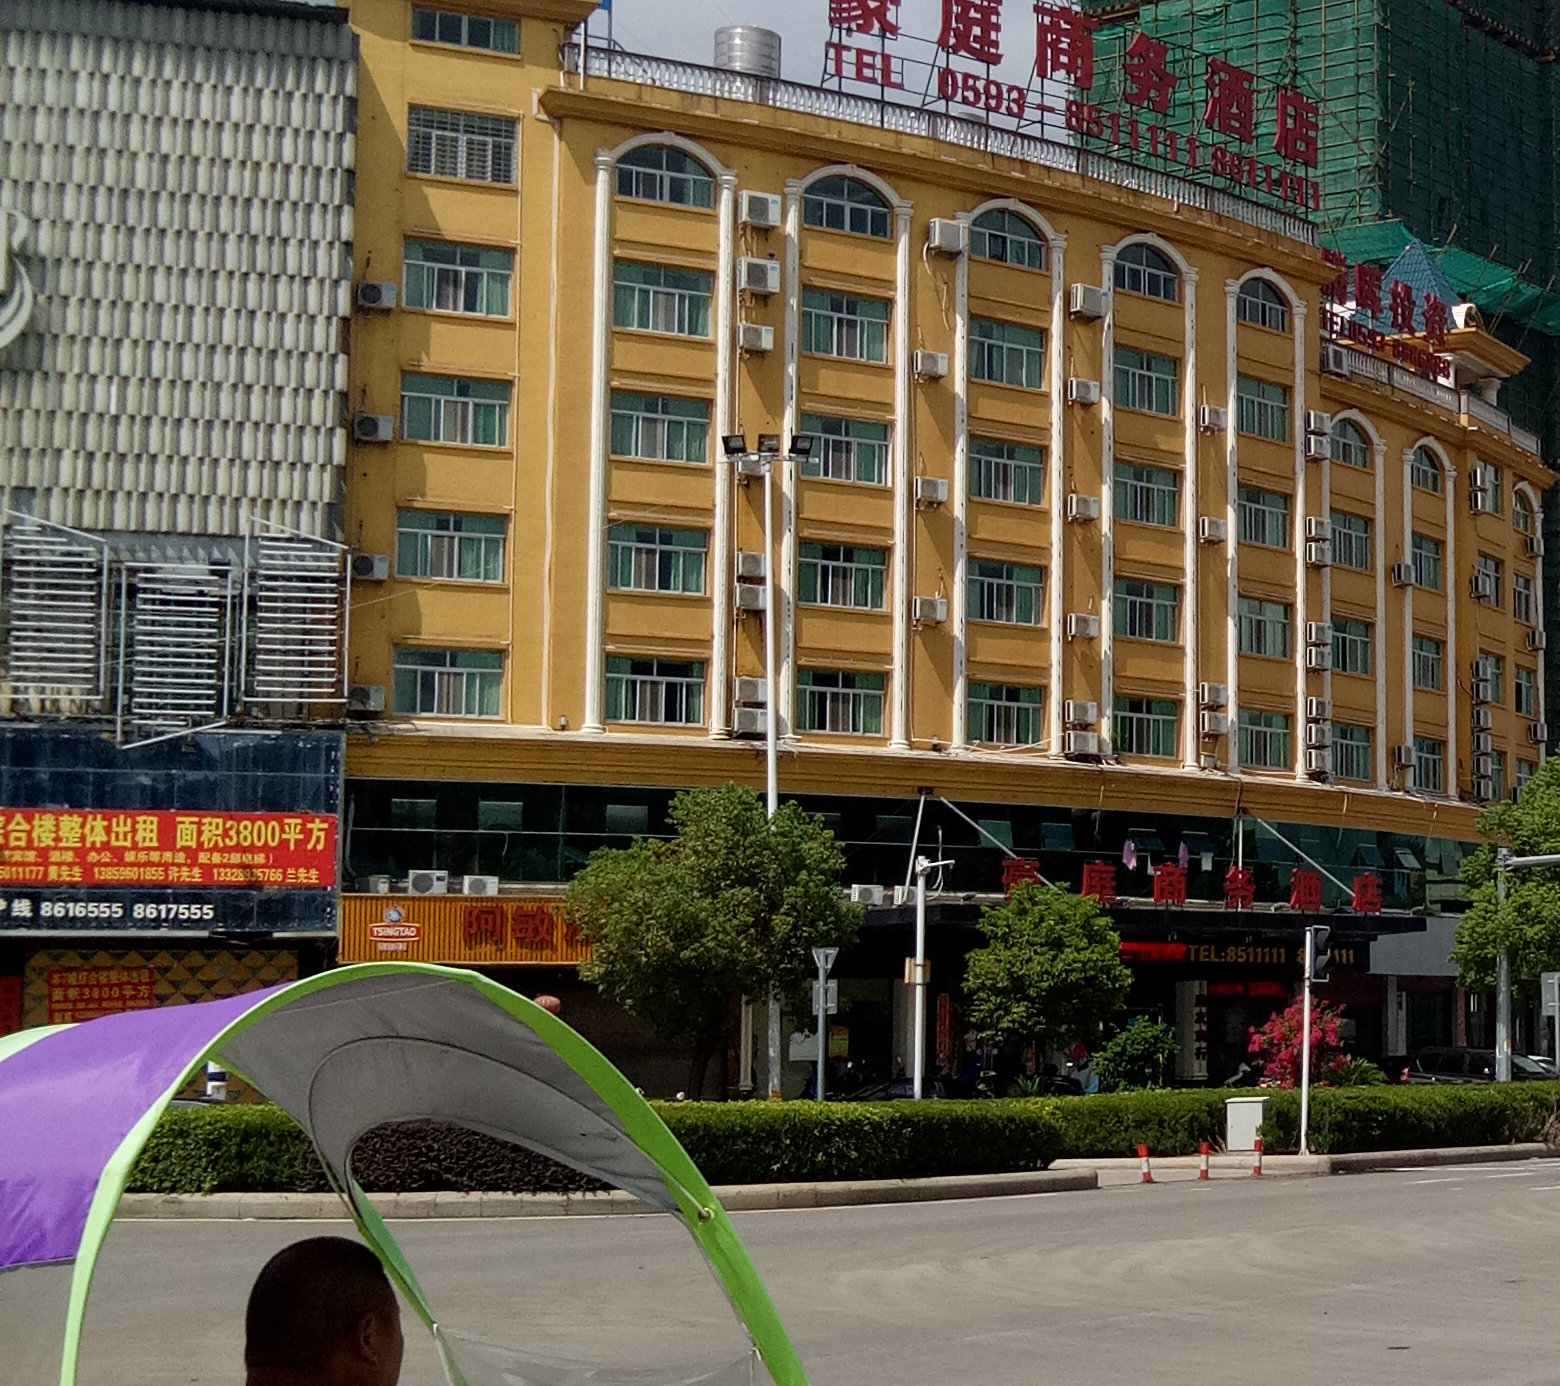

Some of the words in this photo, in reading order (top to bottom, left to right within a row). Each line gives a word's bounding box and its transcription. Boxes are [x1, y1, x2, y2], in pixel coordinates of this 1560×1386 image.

[825, 40, 905, 91] TEL
[175, 816, 329, 851] 面积3800平方
[40, 901, 124, 919] 8616555
[132, 903, 215, 920] 8617555
[372, 926, 417, 938] TSINGTAO
[1188, 943, 1287, 964] TEL:8511111
